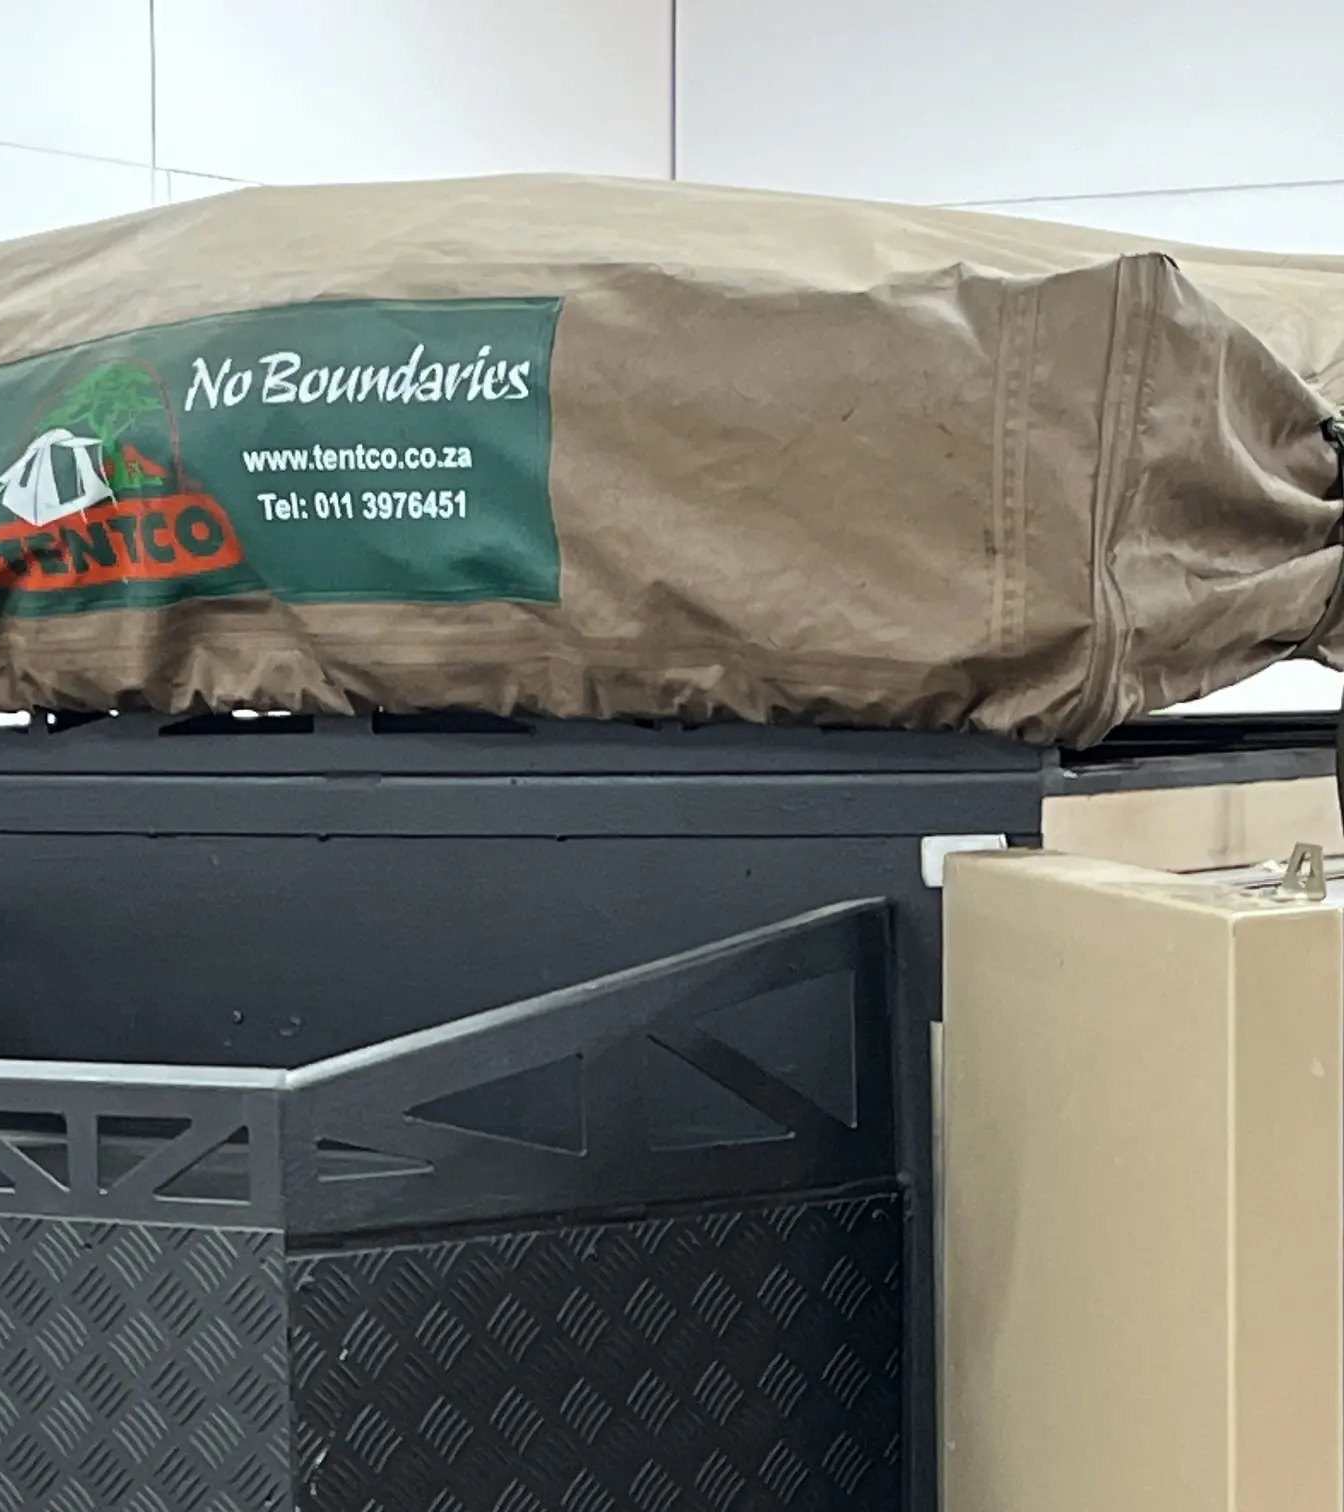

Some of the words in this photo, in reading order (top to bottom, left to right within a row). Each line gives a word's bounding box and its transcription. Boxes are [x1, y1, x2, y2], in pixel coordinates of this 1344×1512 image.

[184, 357, 253, 412] No
[258, 343, 531, 403] Boundaries
[242, 444, 472, 473] www.tentco.co.za
[257, 493, 310, 522] Tel:
[314, 490, 354, 520] 011
[362, 489, 468, 520] 3976451
